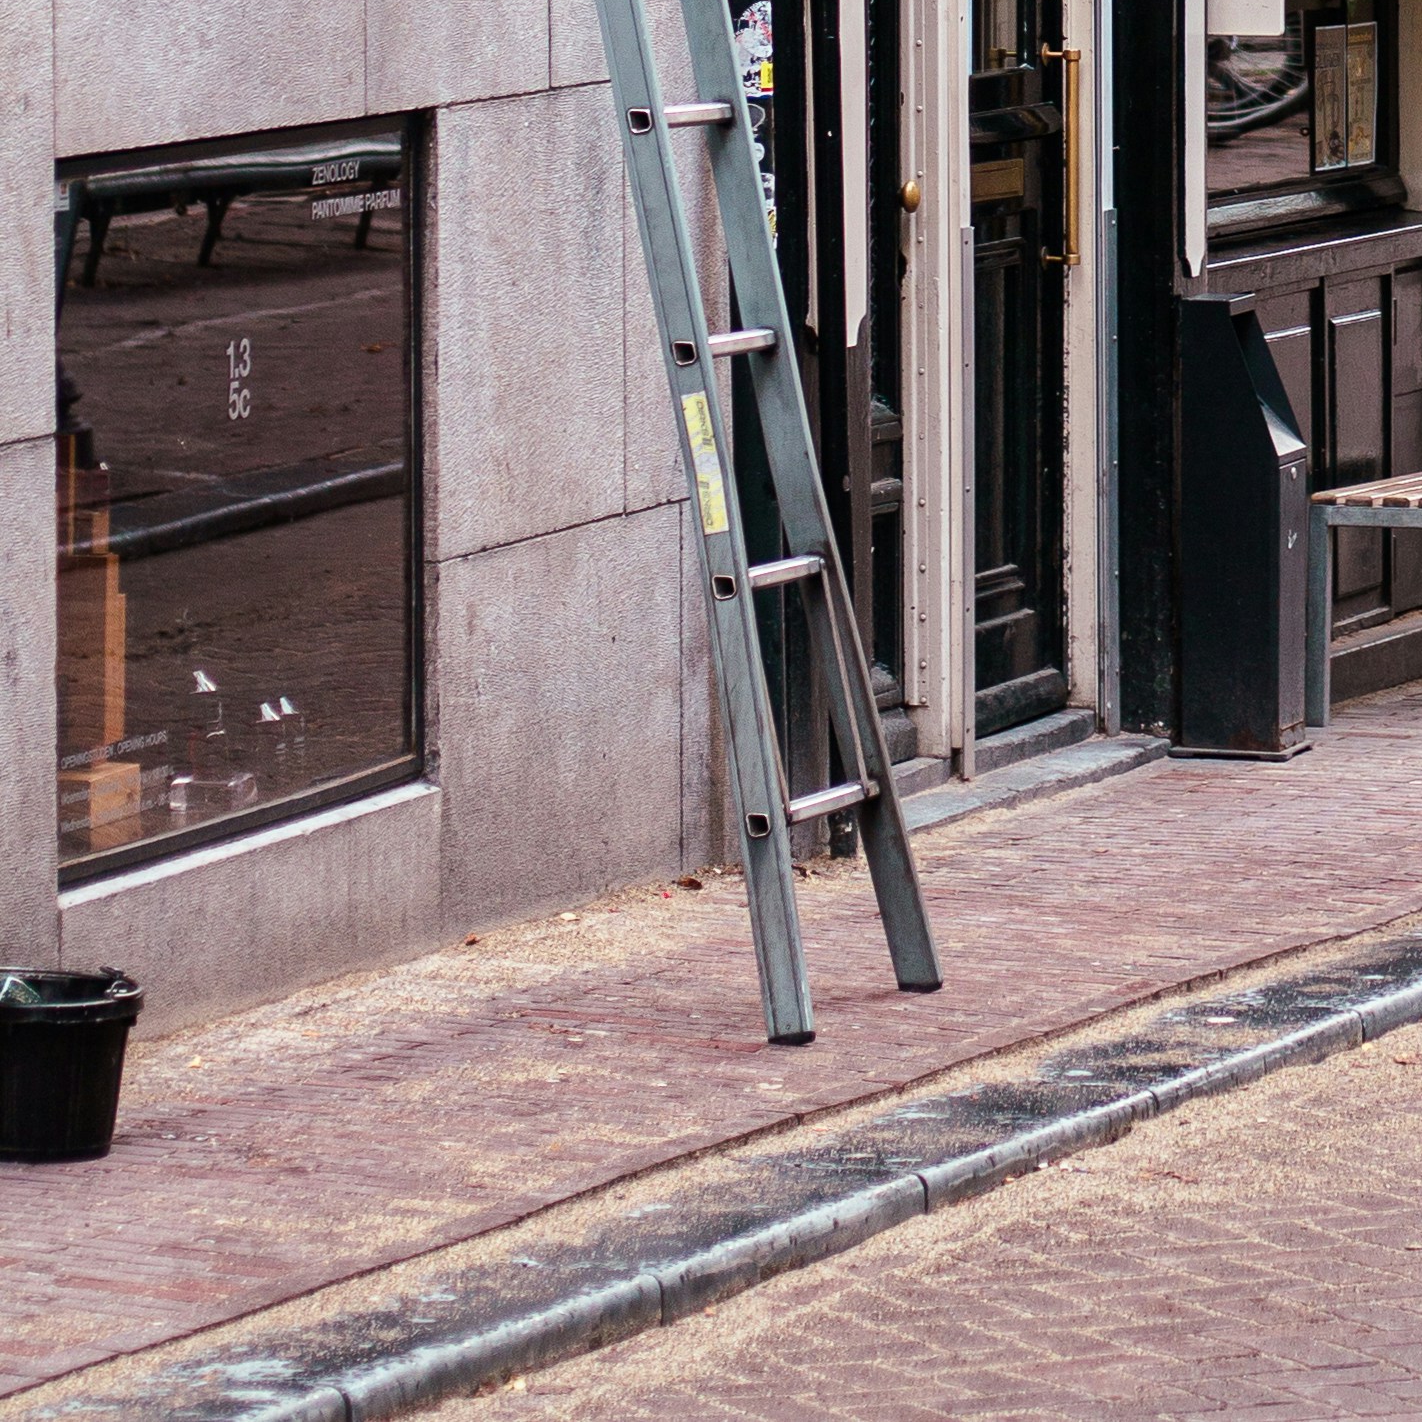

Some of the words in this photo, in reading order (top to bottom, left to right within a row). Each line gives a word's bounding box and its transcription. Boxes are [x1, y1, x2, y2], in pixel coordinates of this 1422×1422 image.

[311, 160, 360, 186] ZENOLOGY
[311, 195, 365, 220] PANTOMIME
[365, 188, 401, 211] PARFUM
